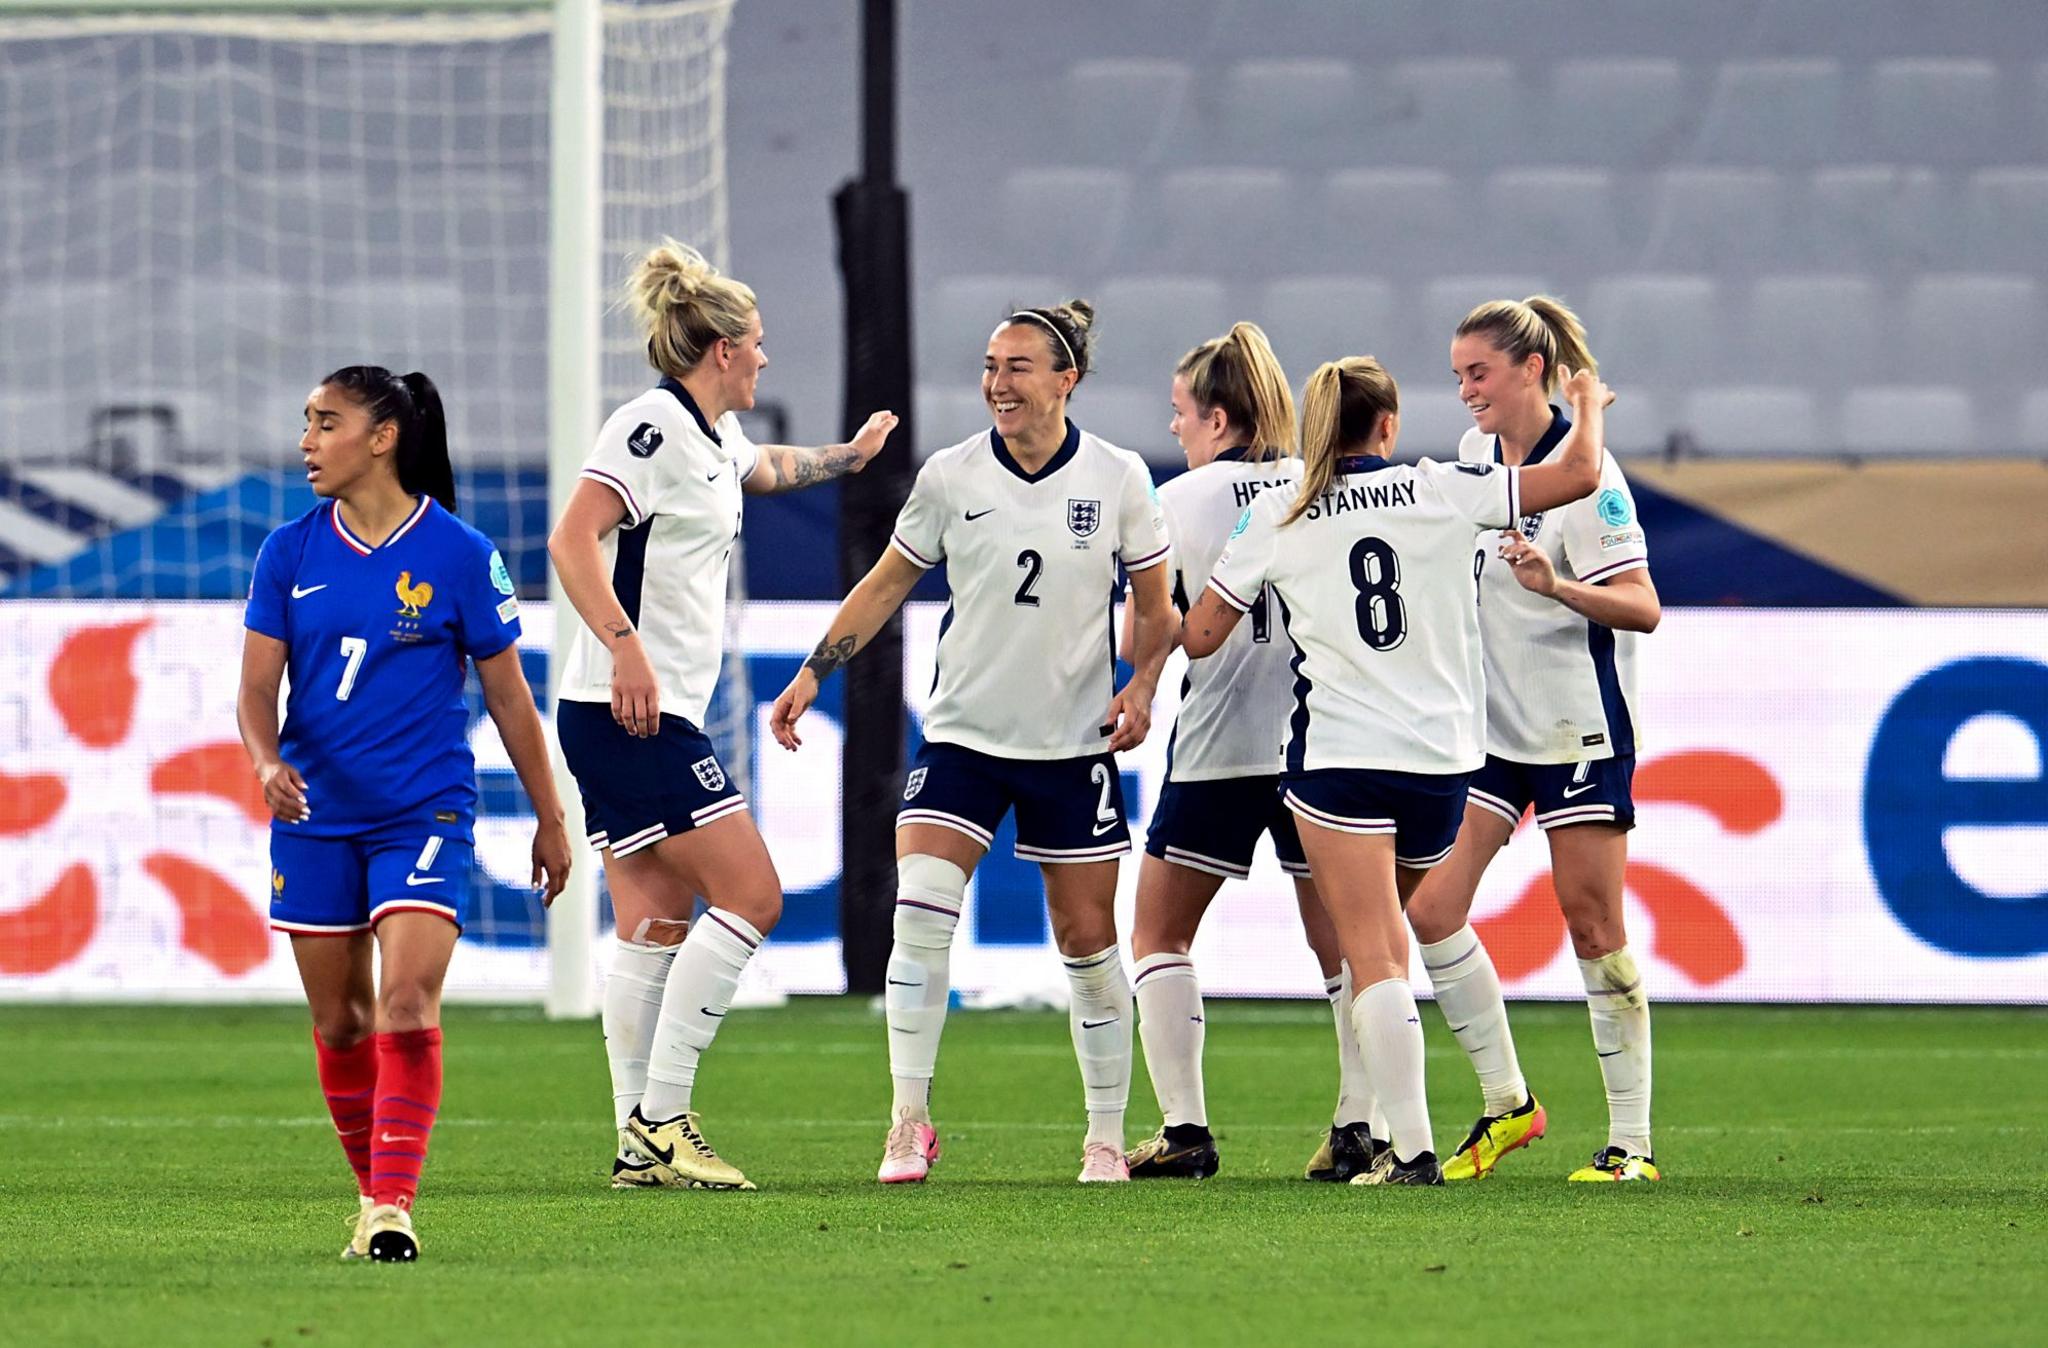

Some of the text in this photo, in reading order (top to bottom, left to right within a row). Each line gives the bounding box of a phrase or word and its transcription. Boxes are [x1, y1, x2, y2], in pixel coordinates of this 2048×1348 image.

[1306, 480, 1417, 520] STANWAY
[1014, 549, 1044, 608] 2
[1348, 537, 1408, 652] 8
[335, 636, 368, 701] 7
[1090, 762, 1118, 822] 2
